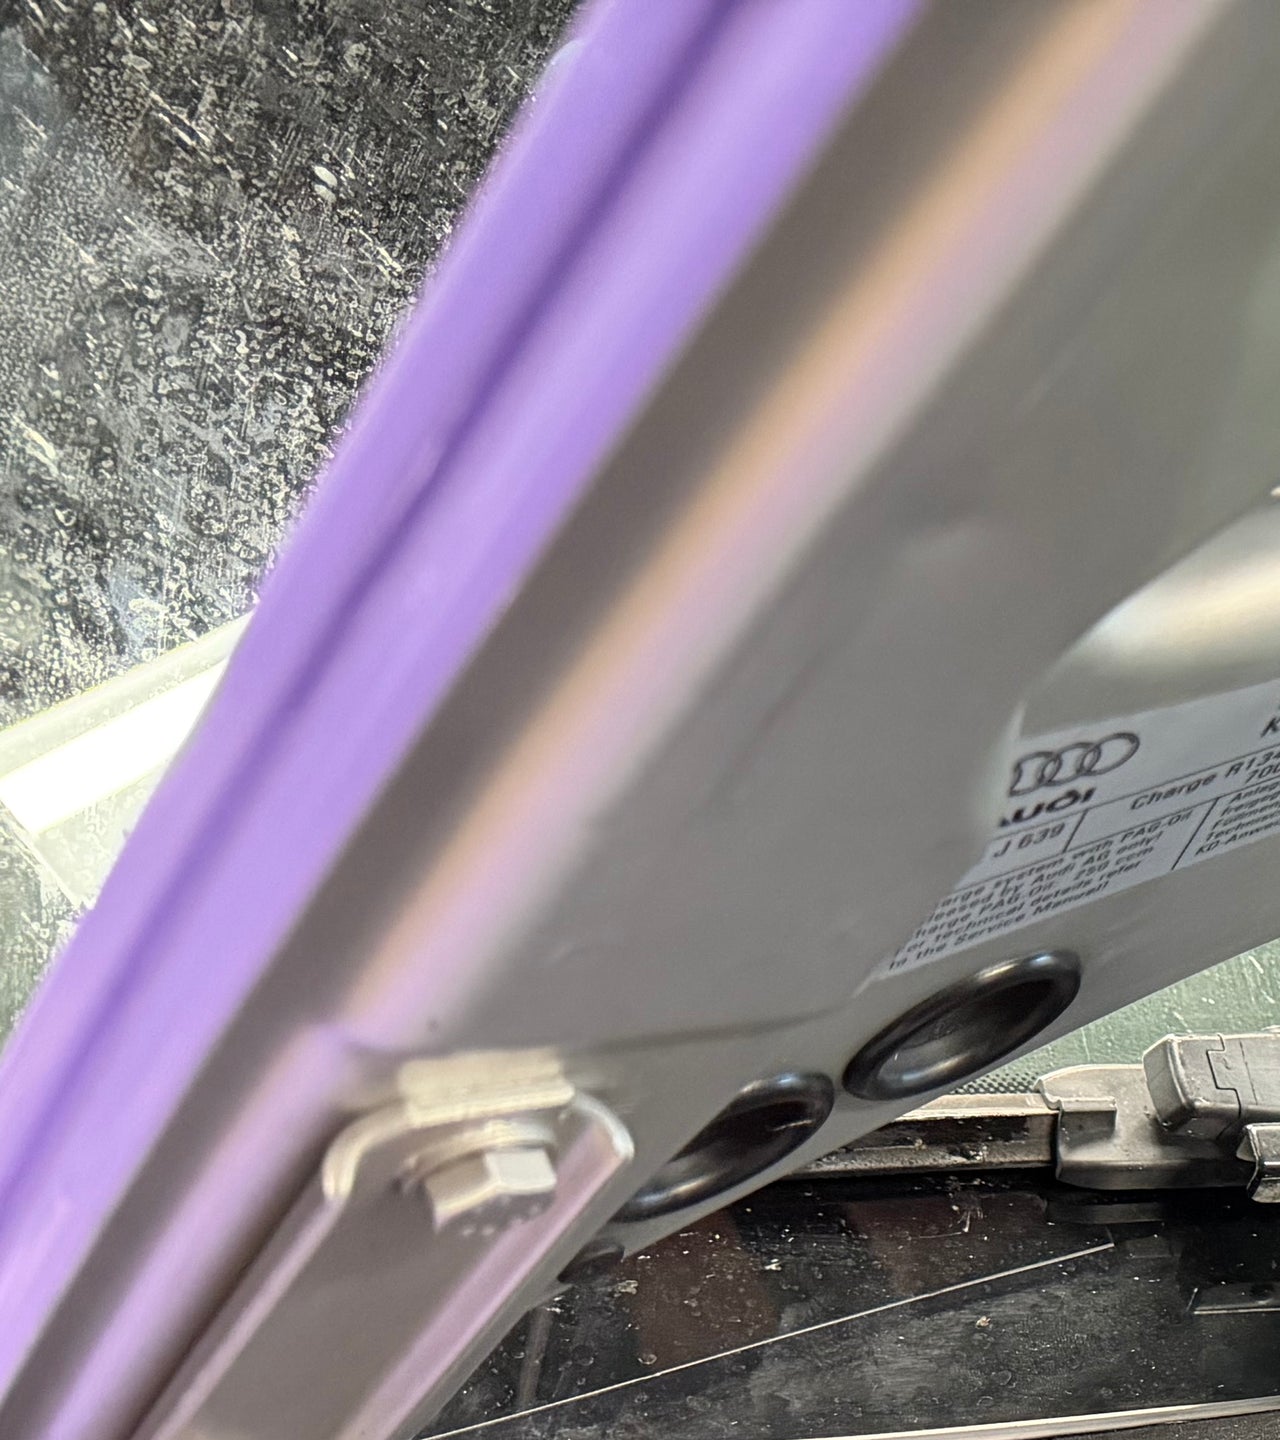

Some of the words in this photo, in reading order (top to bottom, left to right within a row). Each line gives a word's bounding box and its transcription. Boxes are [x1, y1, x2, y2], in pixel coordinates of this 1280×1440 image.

[1129, 773, 1216, 811] Charge
[940, 885, 985, 907] arge
[993, 857, 1064, 889] system
[1071, 839, 1113, 860] with
[1120, 809, 1192, 842] PAG-Oil
[1018, 822, 1066, 849] 639
[914, 912, 971, 938] harge
[1073, 859, 1110, 880] 250
[1114, 845, 1154, 865] ccm
[926, 891, 994, 923] leased
[1030, 862, 1075, 886] Audi
[1081, 849, 1110, 866] AG
[934, 901, 1025, 942] technical
[1029, 878, 1092, 906] details
[1098, 860, 1141, 881] refer
[915, 942, 947, 960] the
[953, 912, 1025, 945] Service
